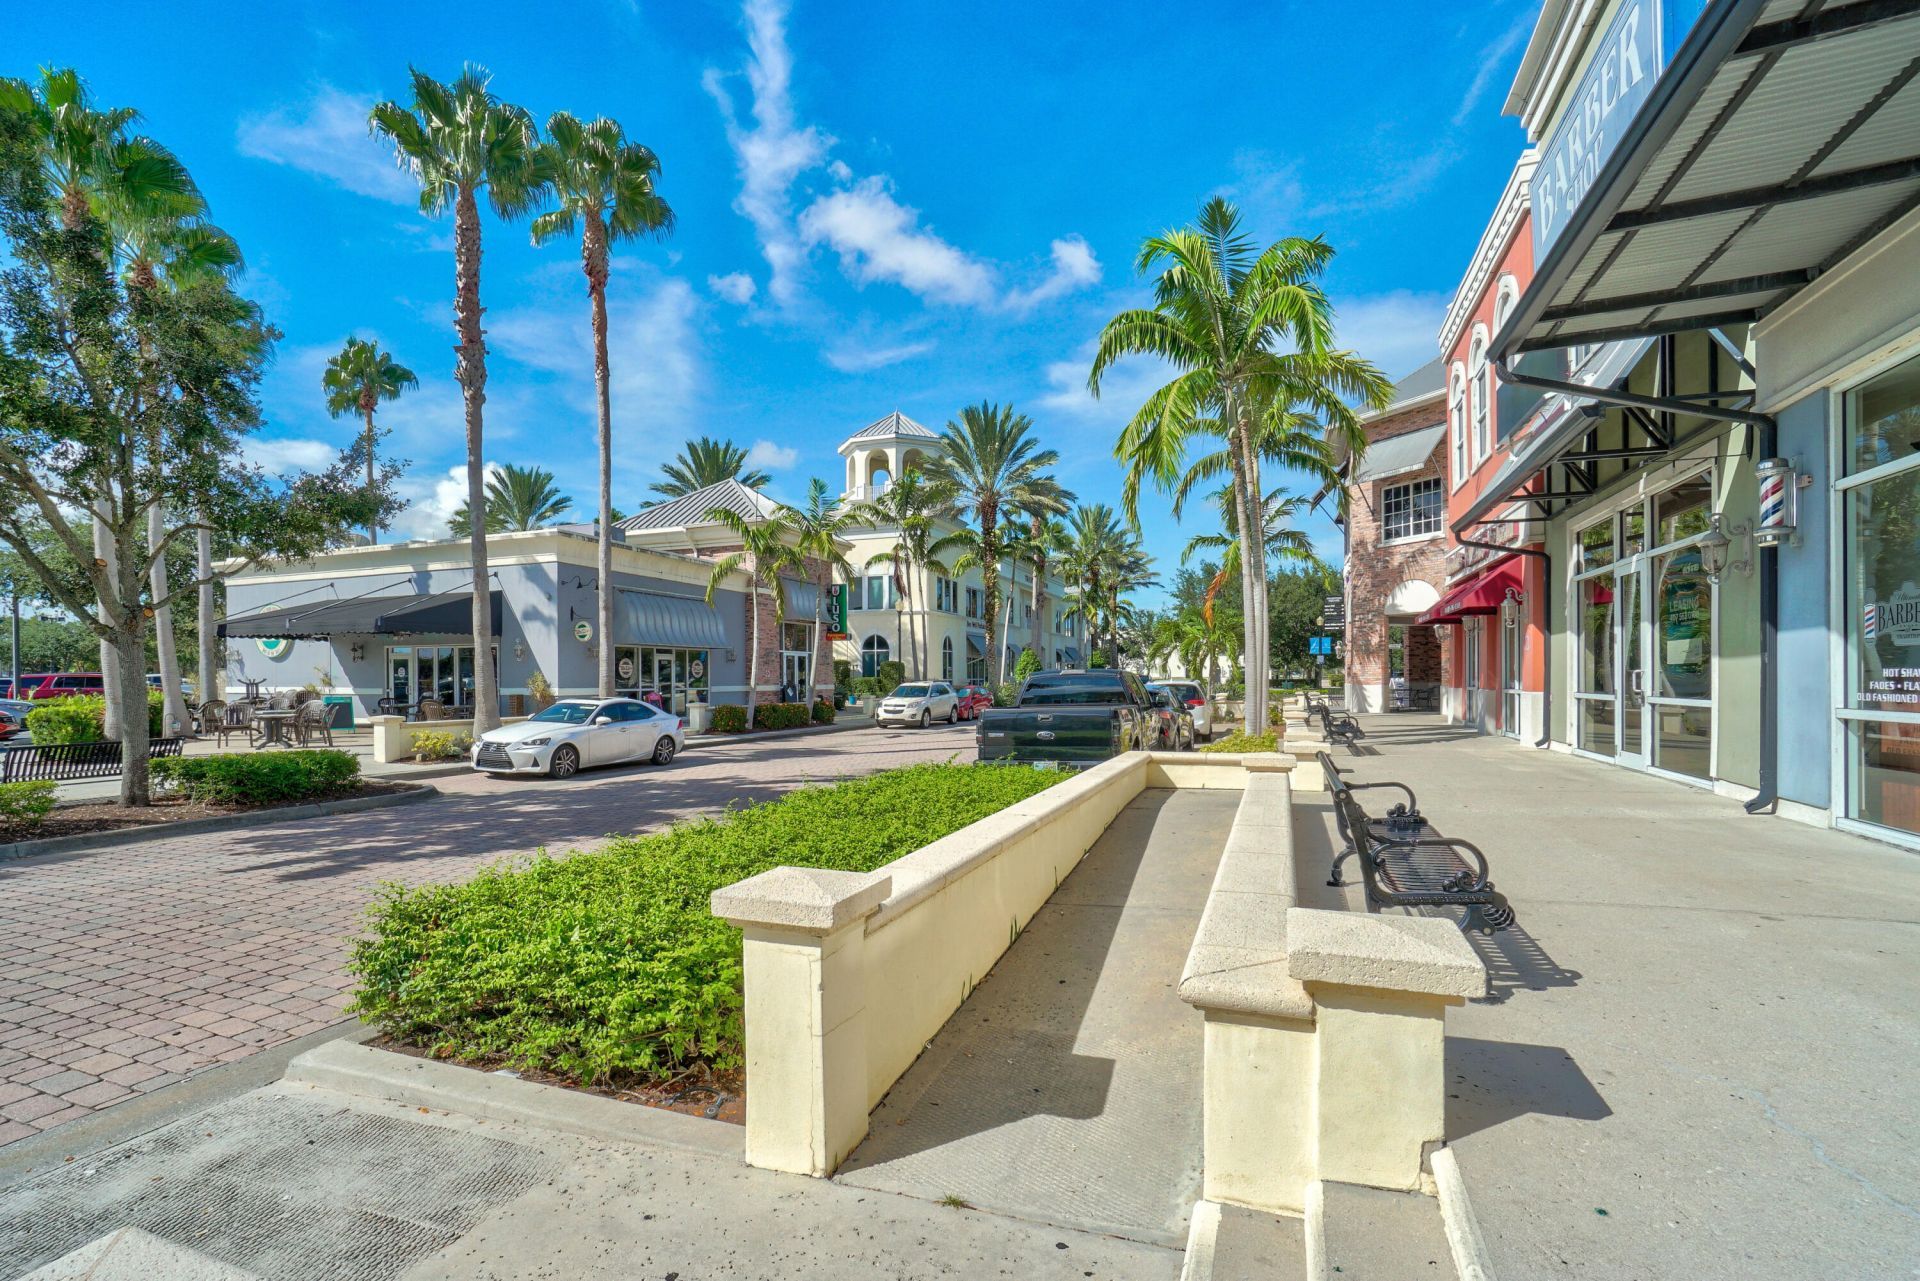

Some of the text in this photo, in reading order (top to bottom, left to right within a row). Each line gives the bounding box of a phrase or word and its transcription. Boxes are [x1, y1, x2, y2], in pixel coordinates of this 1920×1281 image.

[1538, 4, 1644, 246] BARBER
[1565, 130, 1604, 219] SHOP
[1882, 668, 1900, 678] HOT
[1869, 681, 1896, 691] FADES
[1856, 692, 1918, 704] OLD FASHIONED
